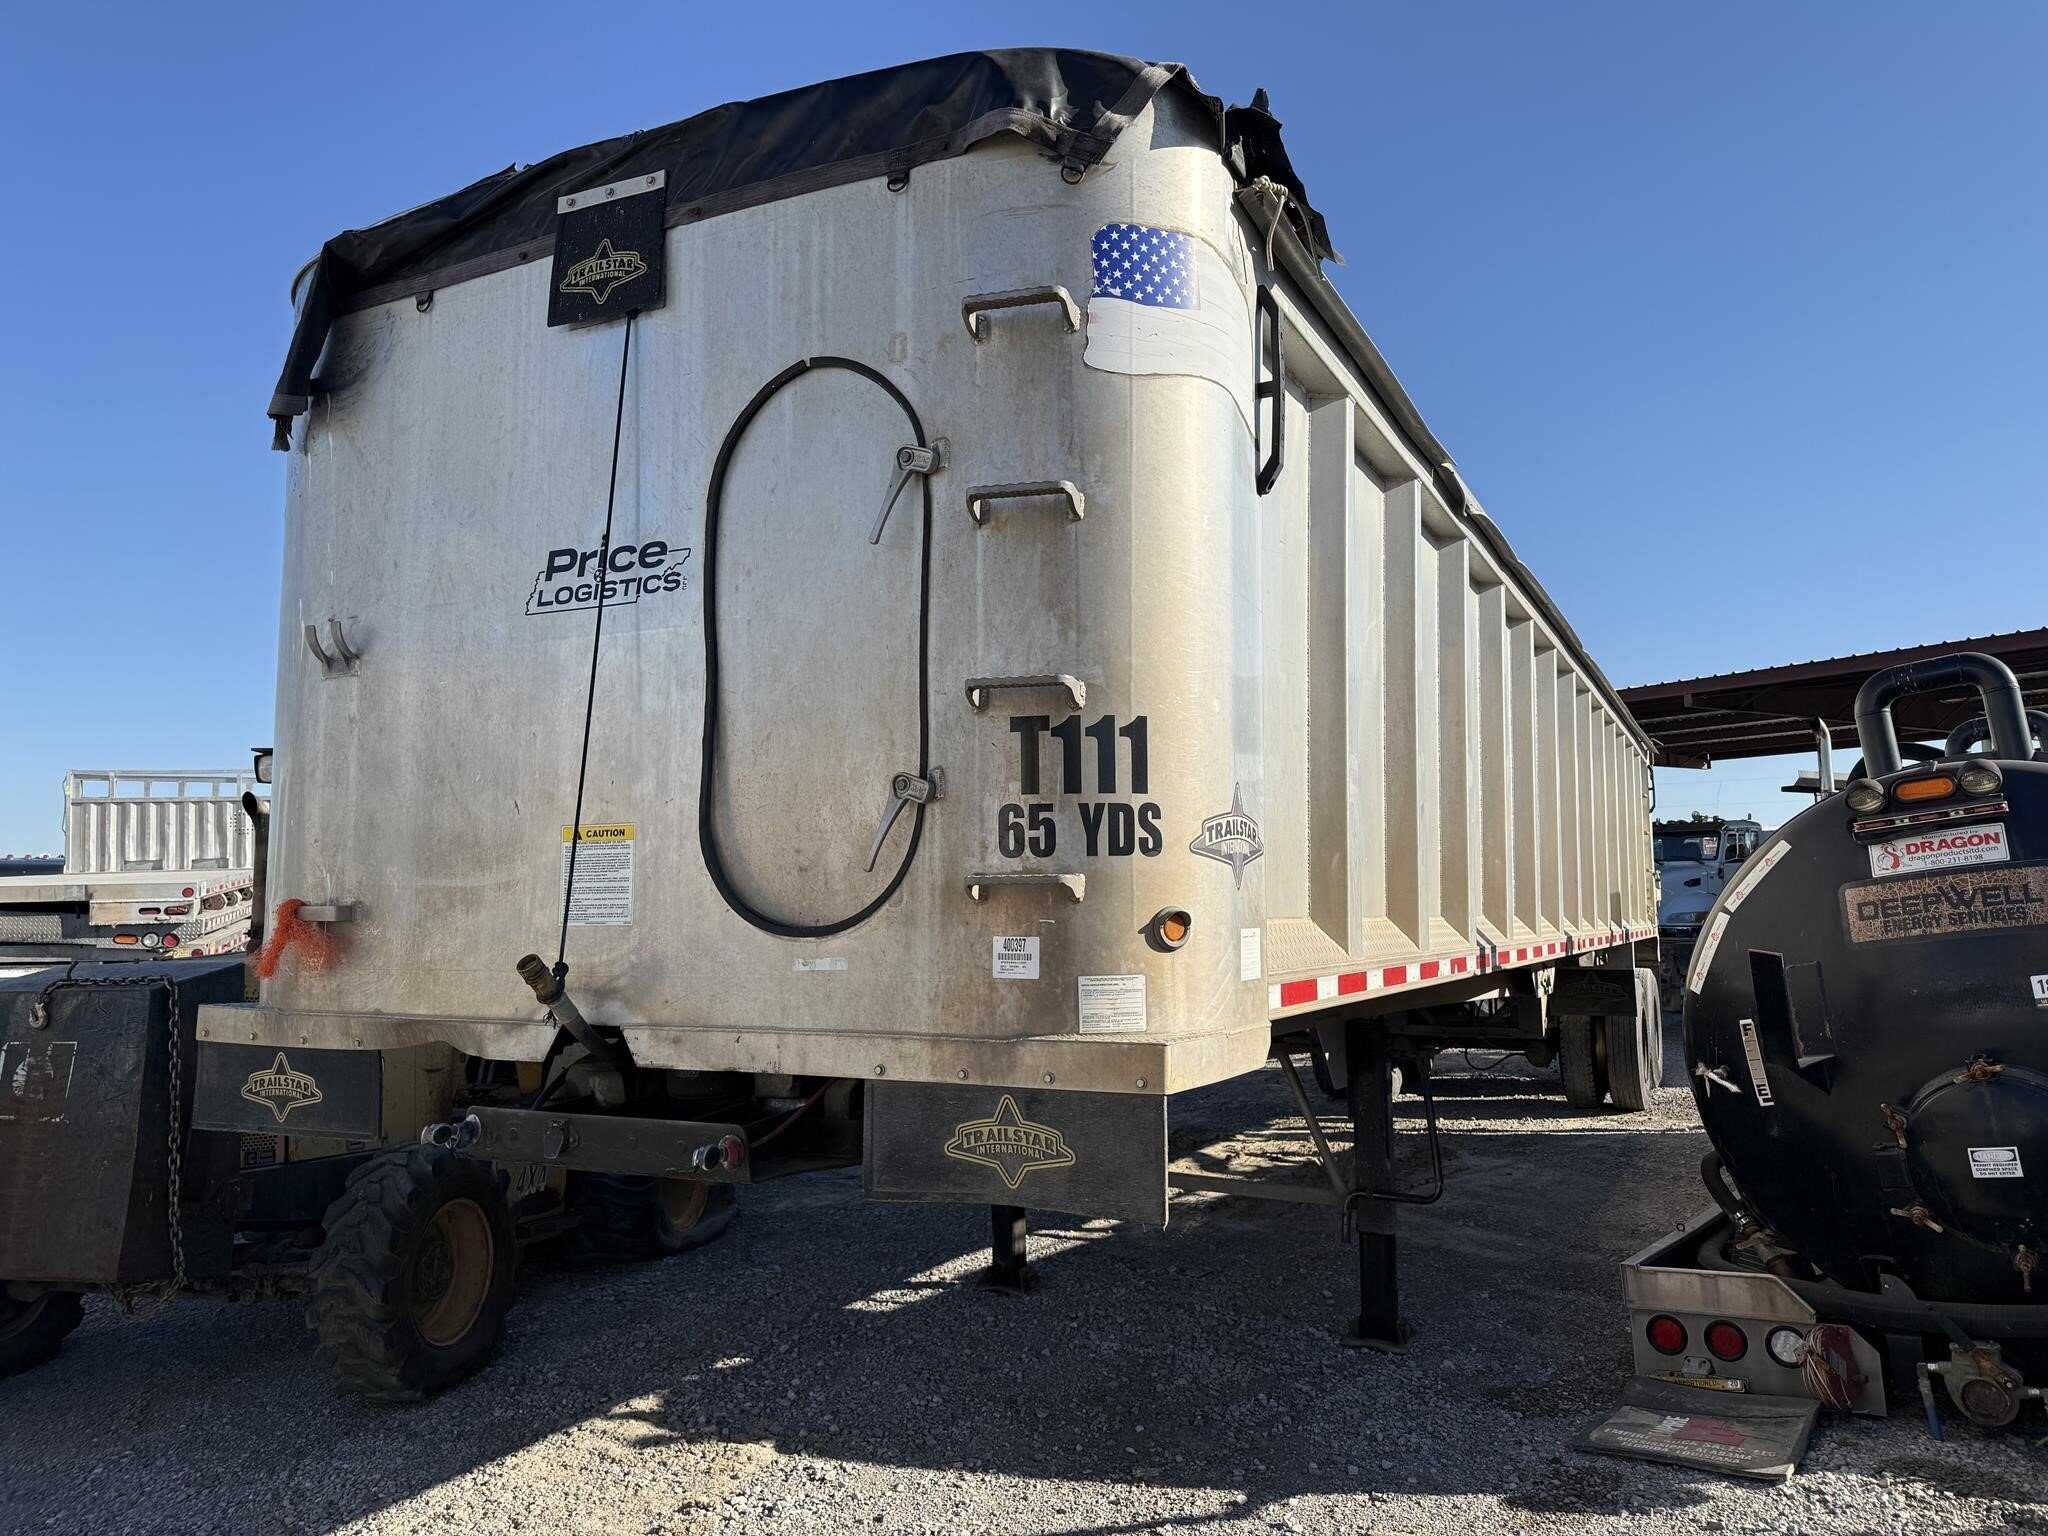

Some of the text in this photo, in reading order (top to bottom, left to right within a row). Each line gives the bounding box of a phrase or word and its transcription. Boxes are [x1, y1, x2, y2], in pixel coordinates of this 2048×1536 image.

[572, 258, 635, 283] TRAILSTAR
[545, 541, 668, 582] Price
[537, 571, 682, 607] LOGISTICS
[1010, 715, 1148, 794] T111
[586, 829, 626, 838] CAUTION
[999, 802, 1163, 858] 65 YDS
[1206, 818, 1257, 844] TRAILSTAR
[1905, 832, 2000, 855] DRAGON
[1857, 882, 2044, 921] DEEPWELL
[253, 1076, 309, 1092] TRAILSTAR
[964, 1126, 1056, 1151] TRAILSTAR
[976, 1144, 1045, 1160] INTERNATIONAL
